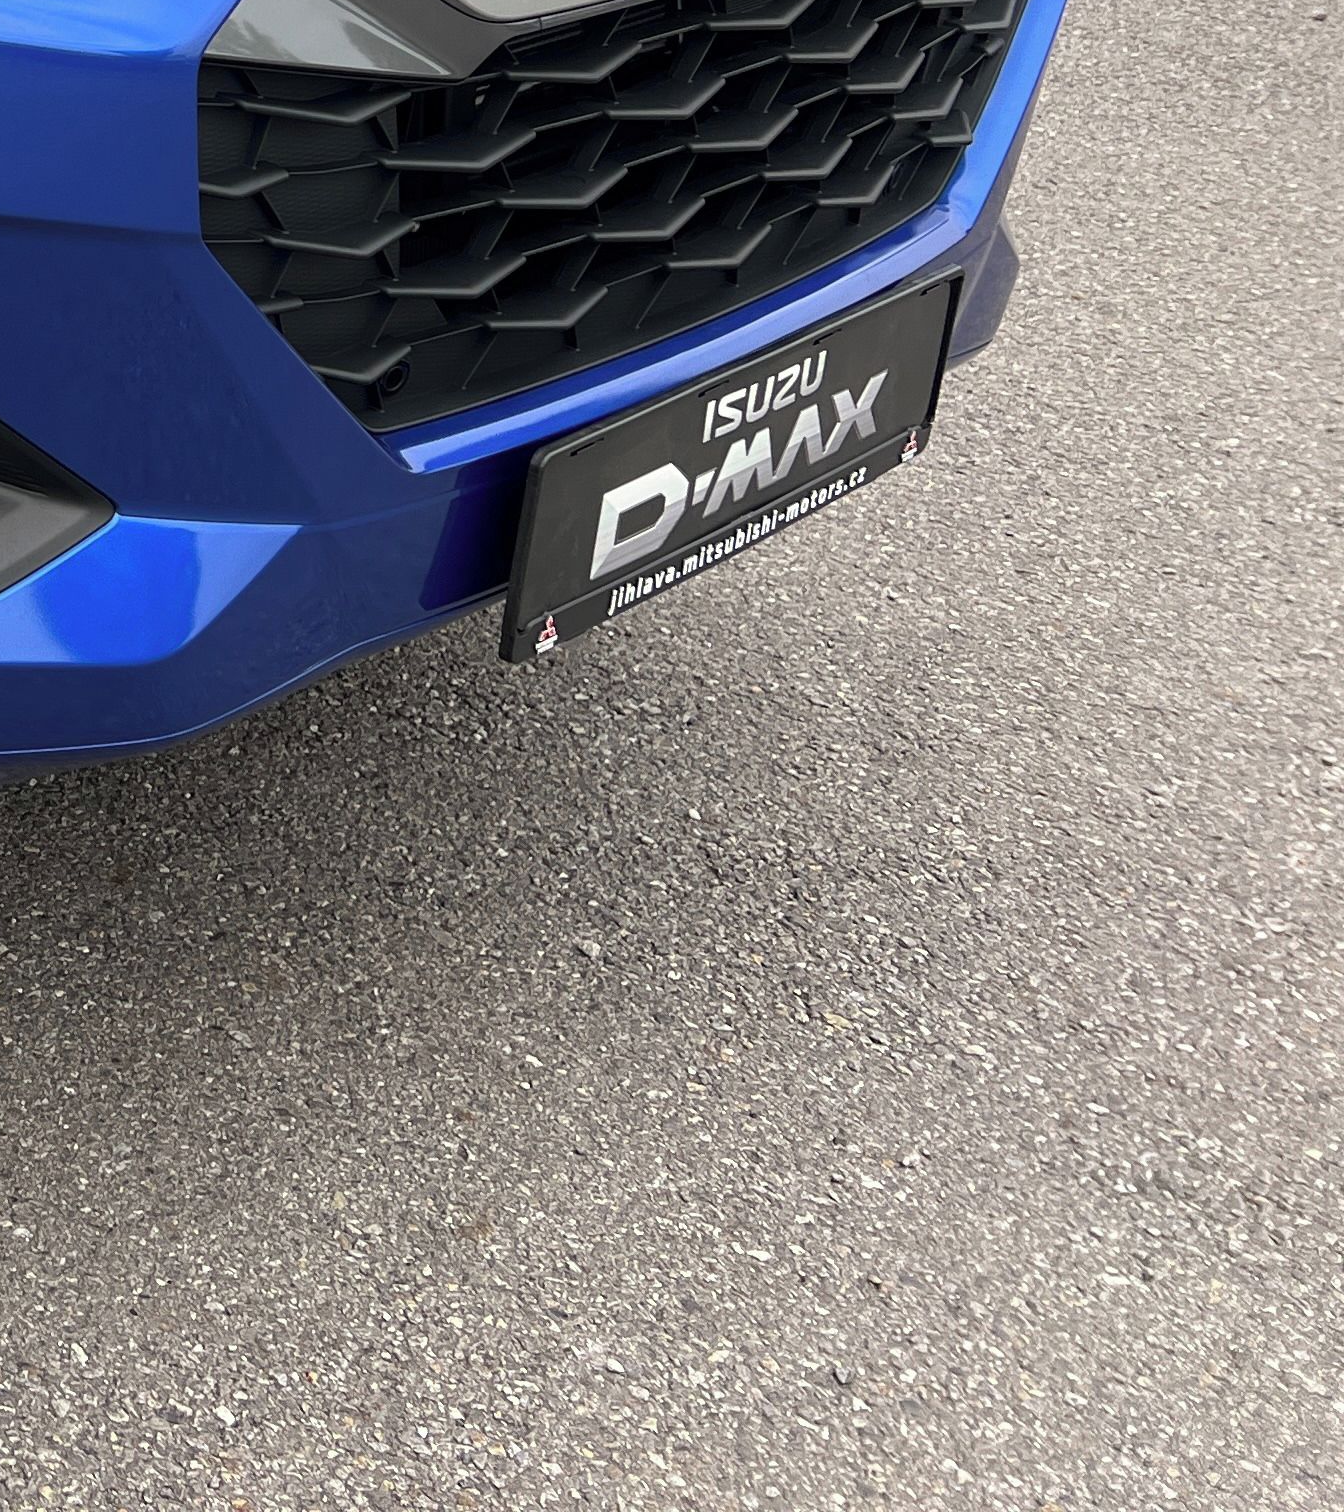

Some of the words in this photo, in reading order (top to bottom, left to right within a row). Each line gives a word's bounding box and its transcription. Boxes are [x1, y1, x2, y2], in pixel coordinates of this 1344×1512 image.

[701, 349, 828, 444] ISUZU
[589, 368, 889, 581] D-MAX
[607, 466, 868, 617] jihlava.mitsubishi-motors.cz
